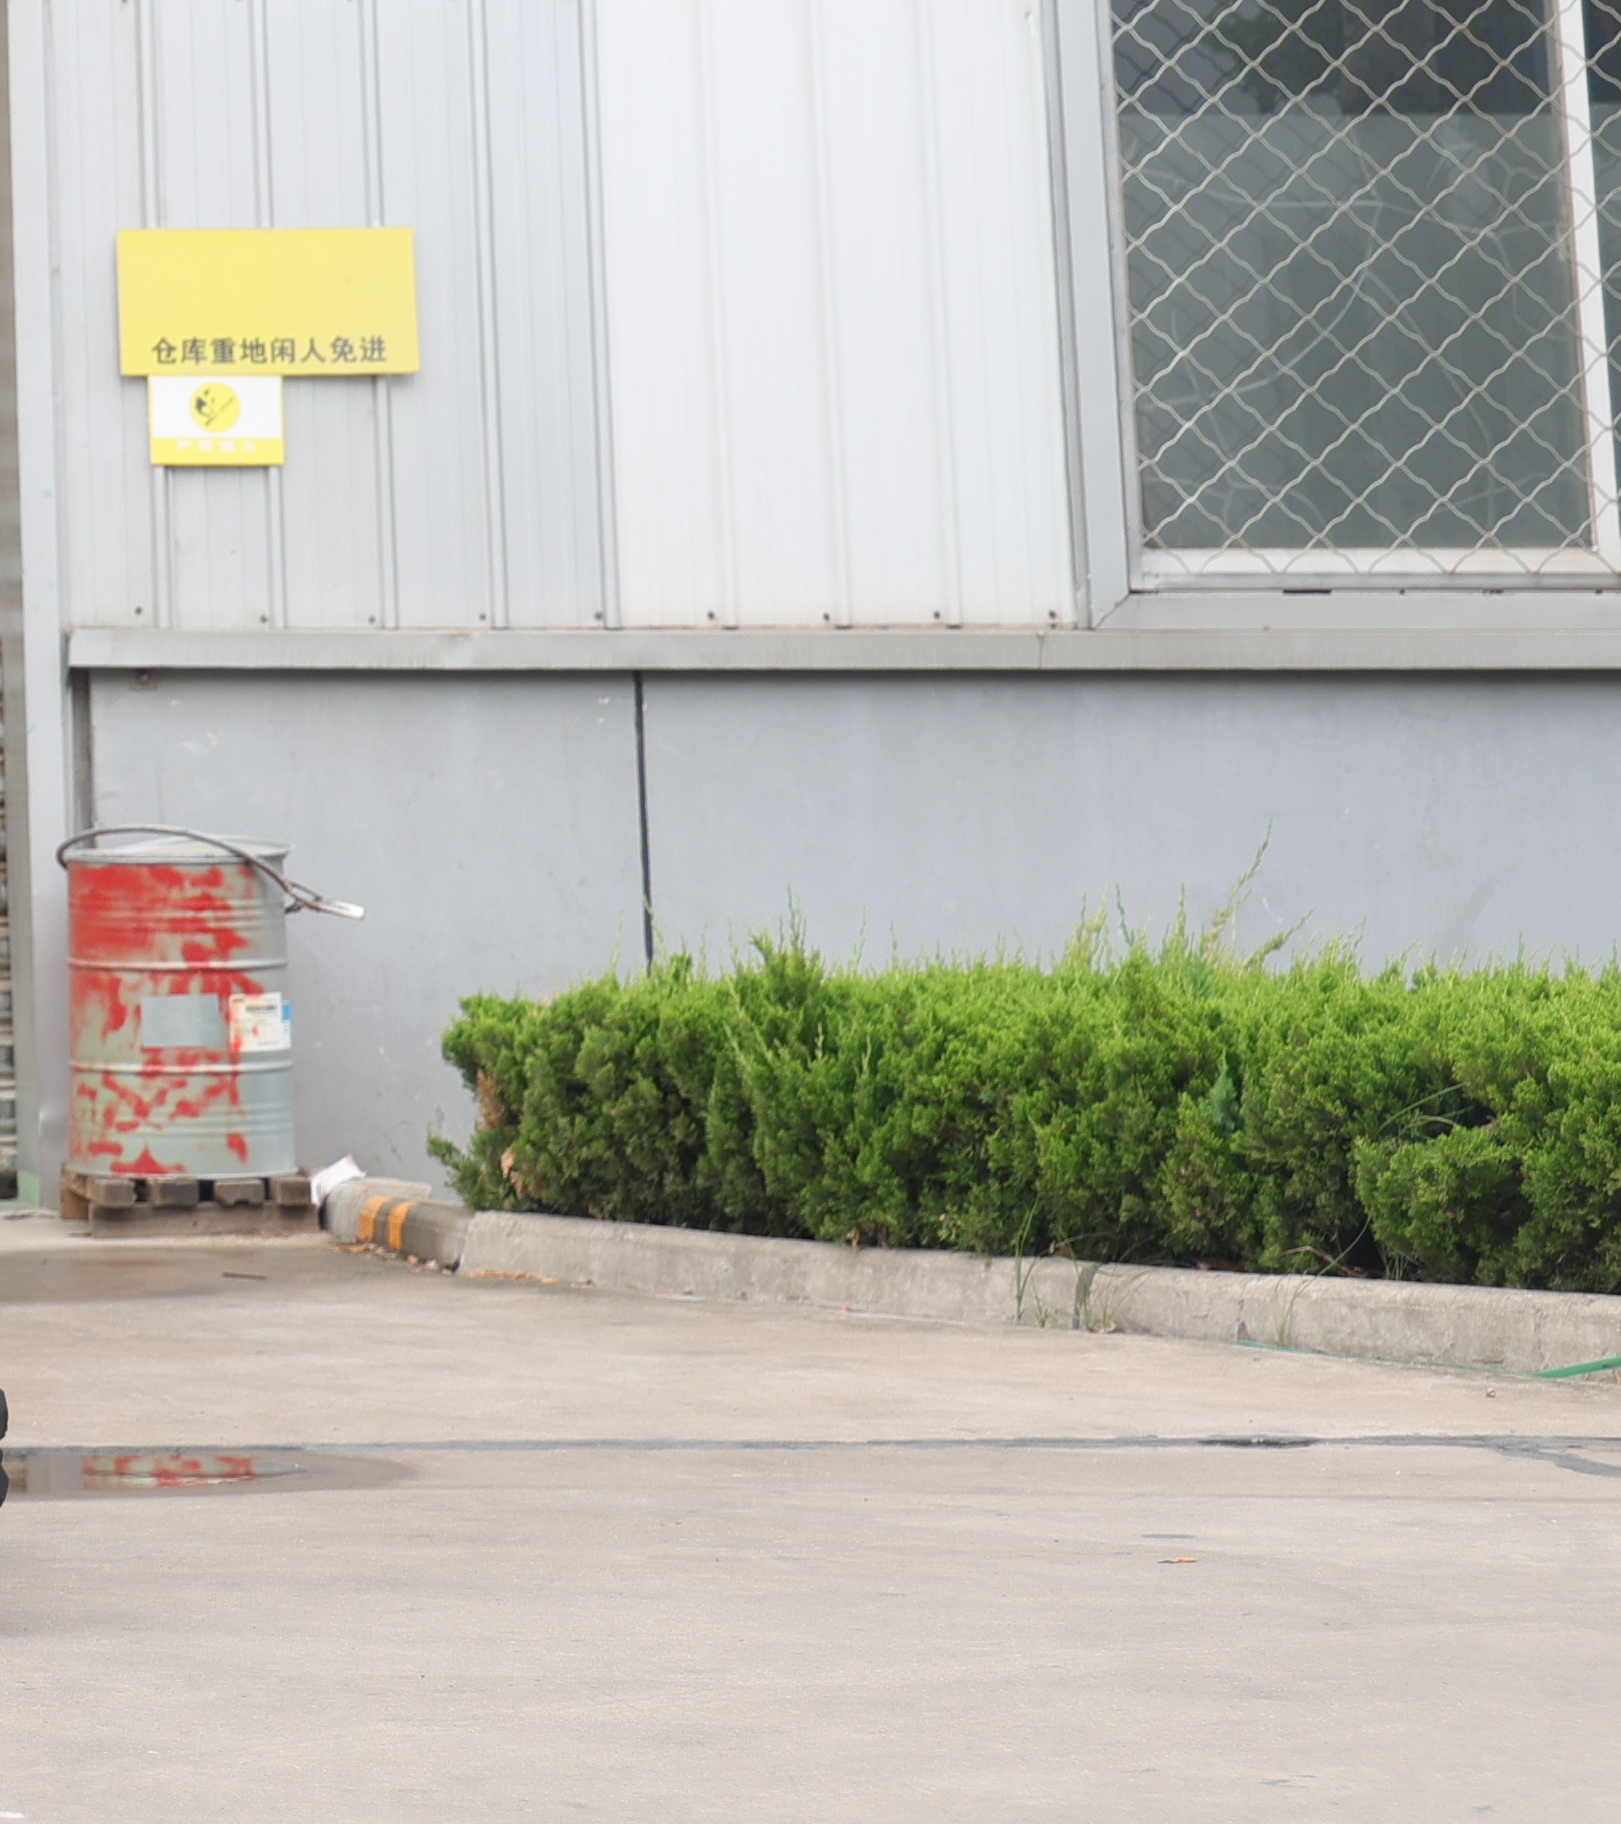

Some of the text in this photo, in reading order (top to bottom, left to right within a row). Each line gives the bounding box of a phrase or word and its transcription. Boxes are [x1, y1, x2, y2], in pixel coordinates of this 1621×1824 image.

[152, 336, 387, 364] 仓库重地闲人免进
